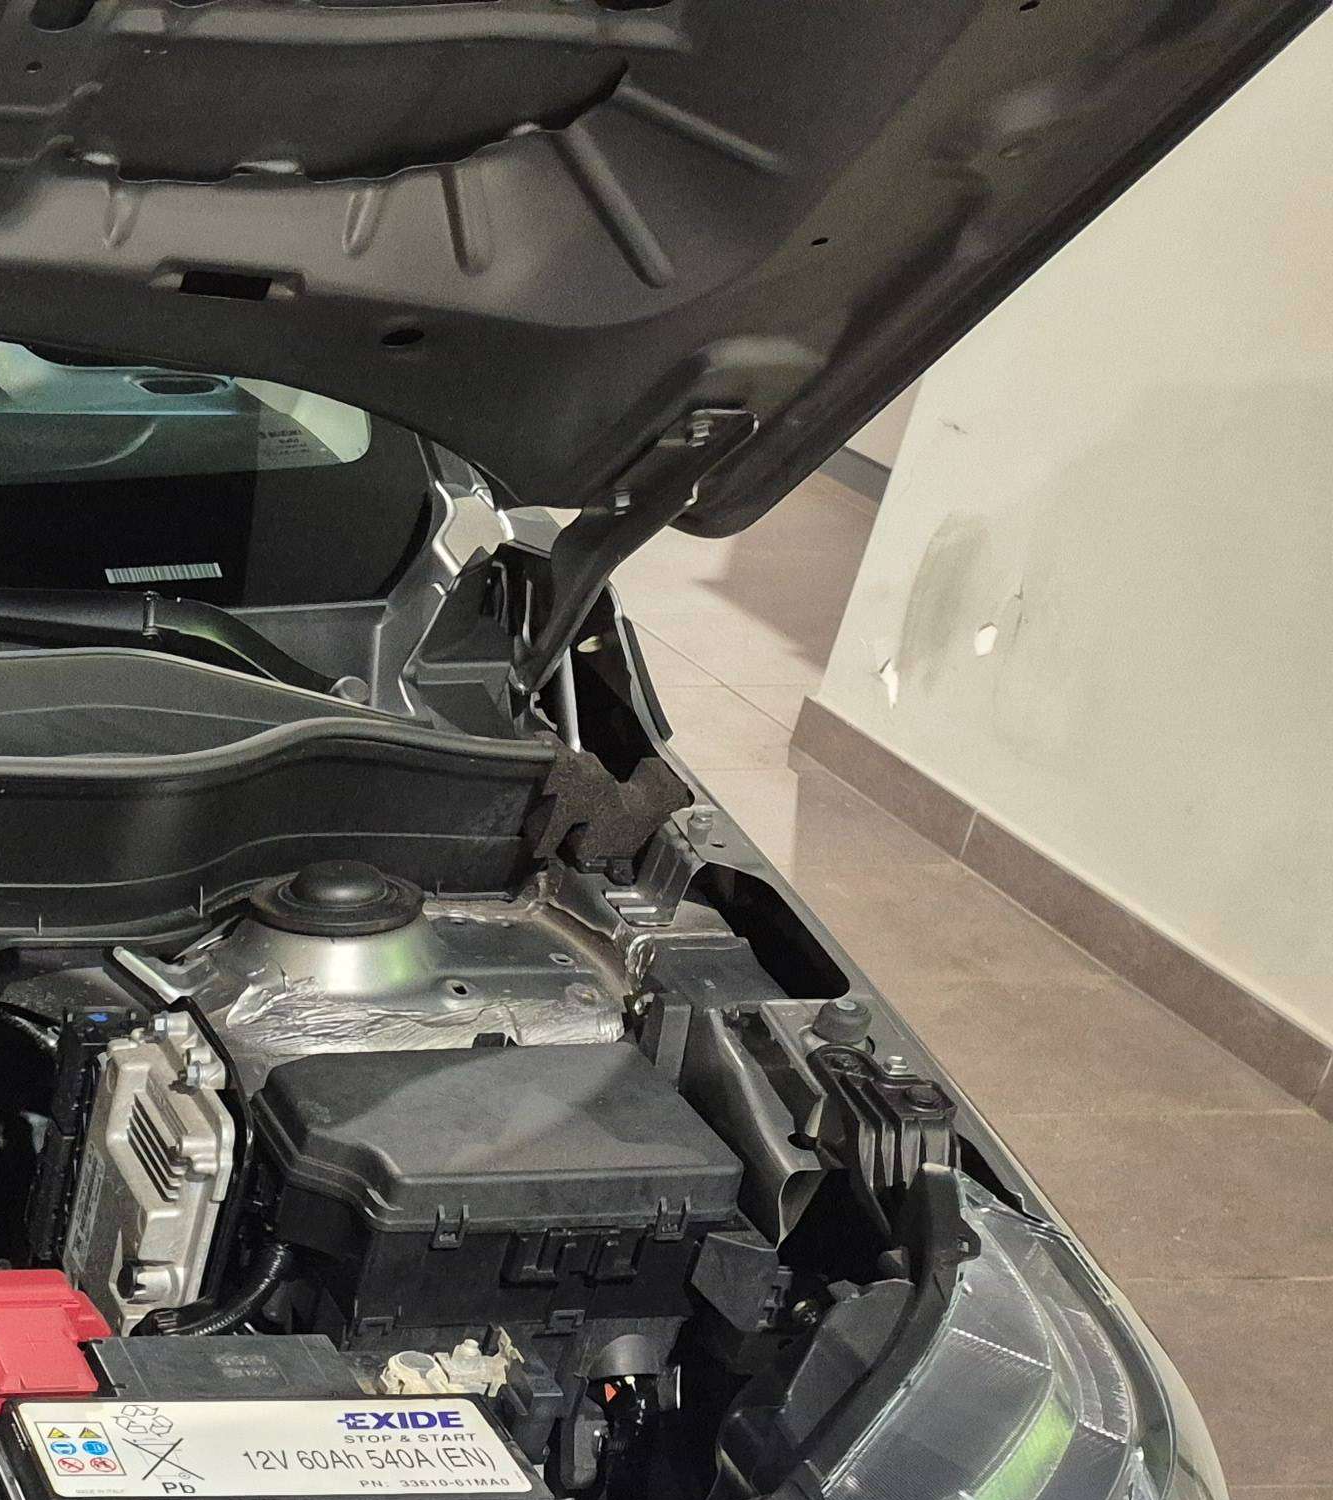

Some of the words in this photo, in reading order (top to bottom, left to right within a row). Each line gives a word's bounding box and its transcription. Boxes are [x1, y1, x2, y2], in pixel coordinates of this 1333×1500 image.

[337, 1410, 464, 1430] EXIDE
[344, 1434, 393, 1444] STOP
[399, 1434, 411, 1443] &
[418, 1432, 476, 1443] START
[243, 1450, 288, 1470] 12V
[296, 1449, 364, 1470] 60Ah
[368, 1449, 436, 1470] 540A
[436, 1447, 497, 1472] (EN)
[162, 1481, 196, 1495] Pb
[359, 1479, 389, 1488] PN:
